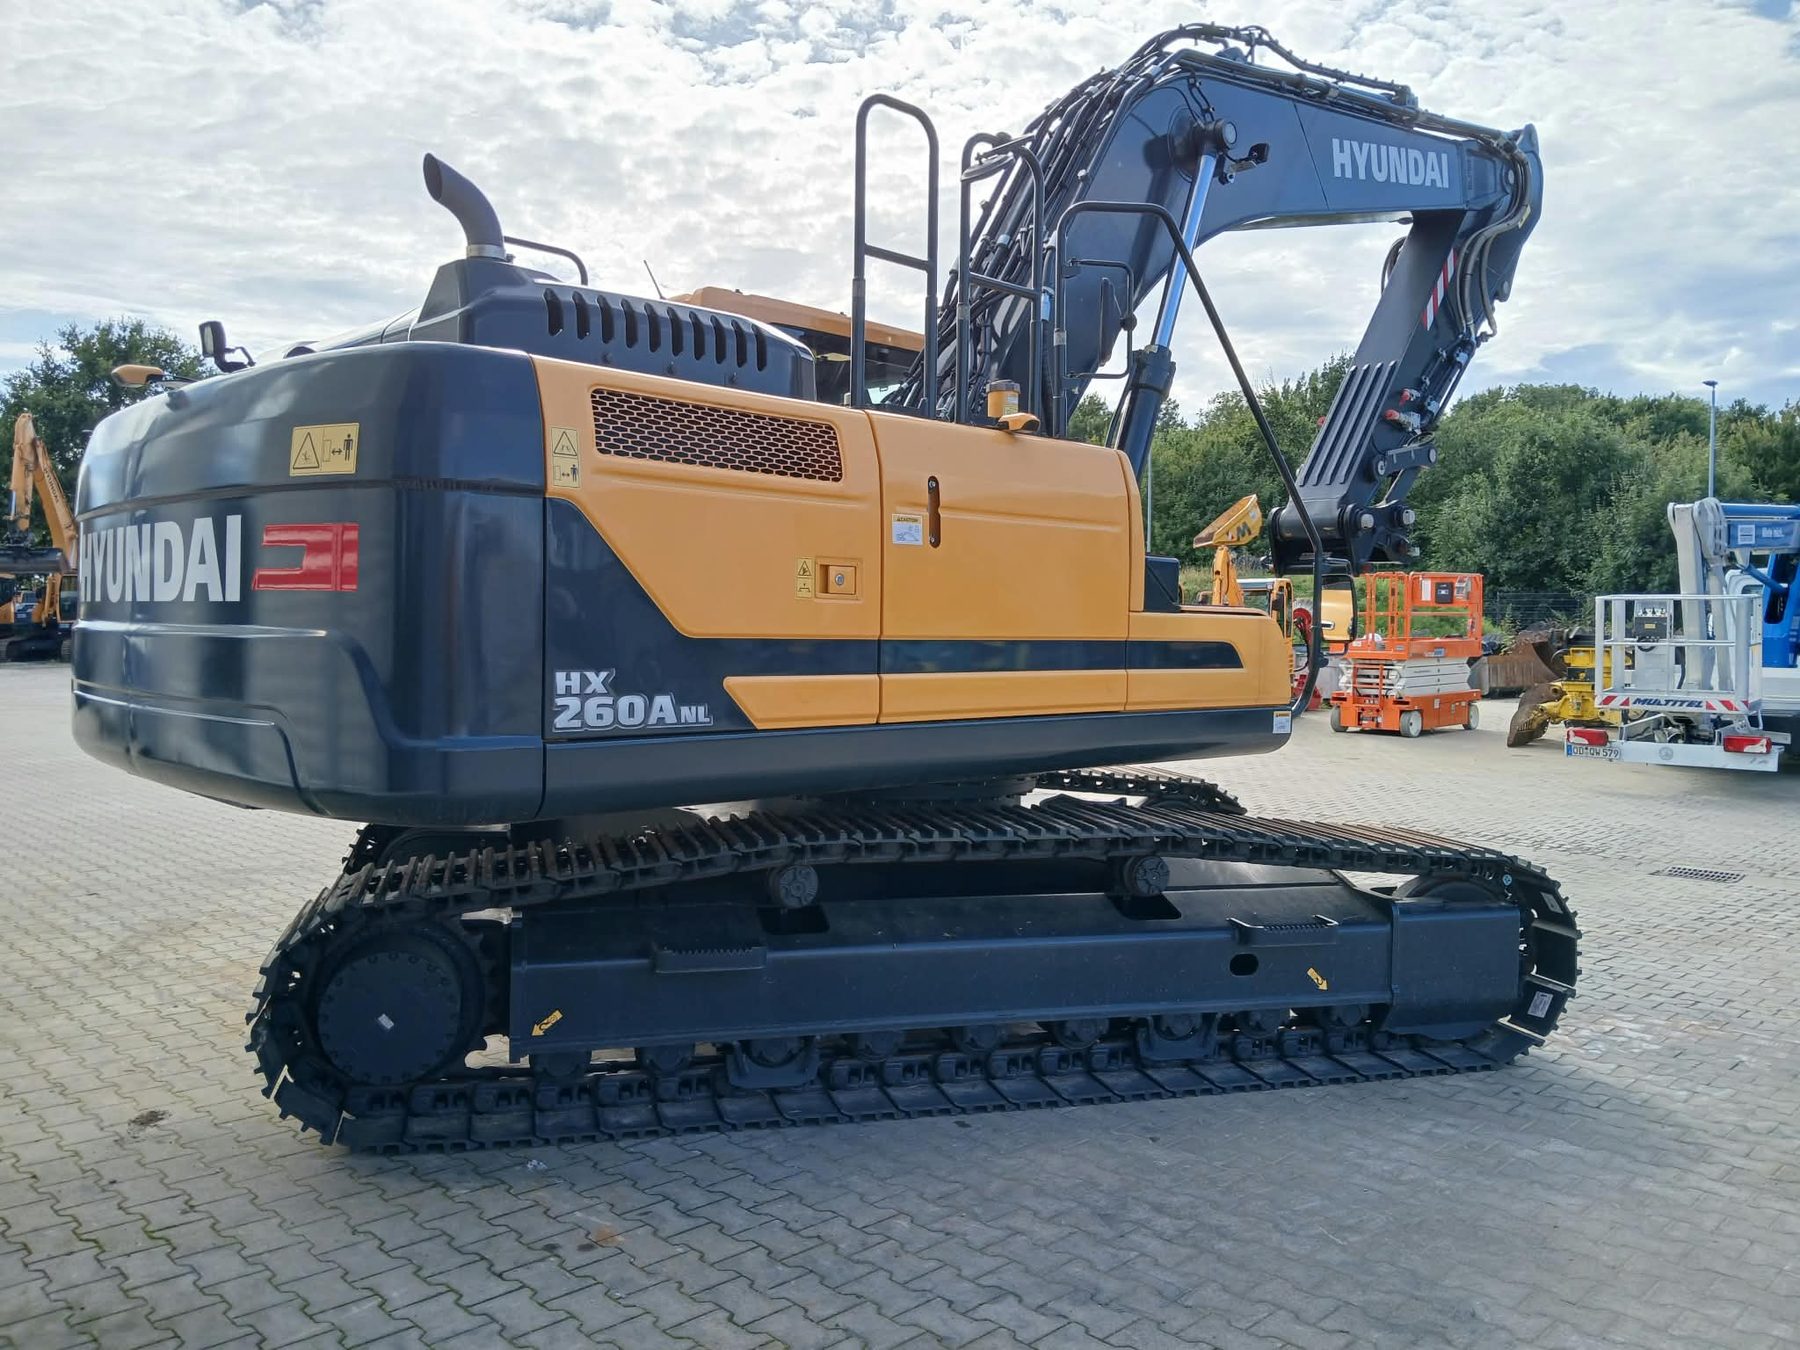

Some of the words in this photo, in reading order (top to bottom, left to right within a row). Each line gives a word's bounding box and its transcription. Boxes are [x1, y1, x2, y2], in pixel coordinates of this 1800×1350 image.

[1332, 138, 1449, 188] HYUNDAI
[80, 515, 242, 602] HYUNDAI
[555, 671, 609, 694] HX
[1632, 697, 1704, 708] MULTITEL
[1602, 748, 1620, 758] 579
